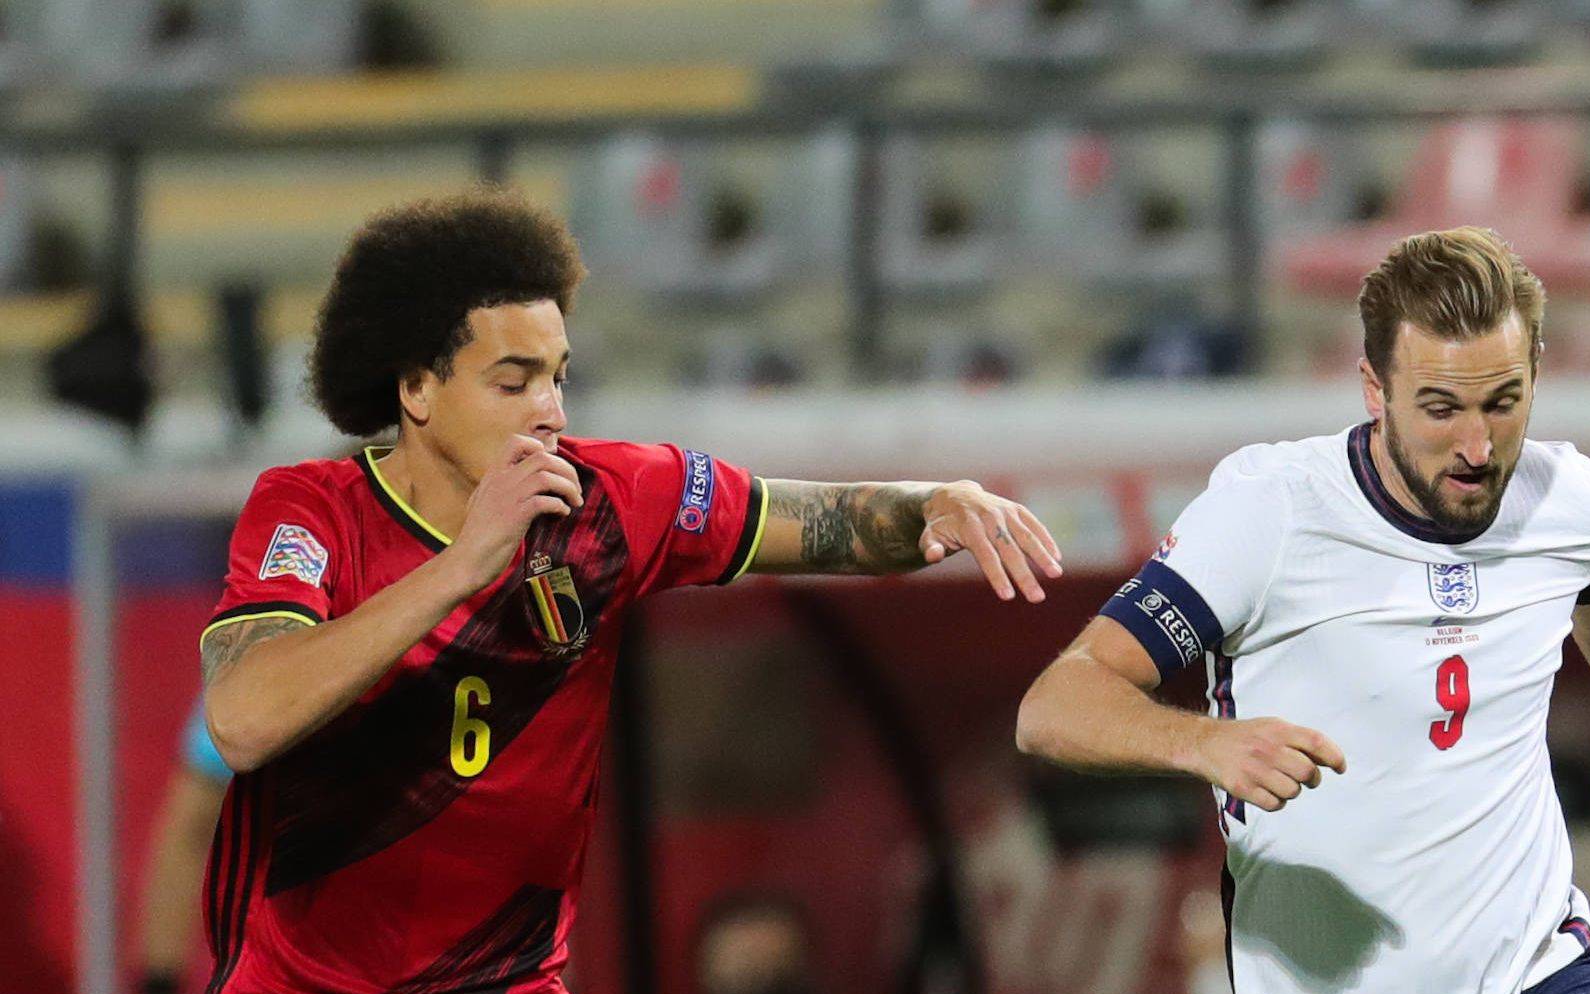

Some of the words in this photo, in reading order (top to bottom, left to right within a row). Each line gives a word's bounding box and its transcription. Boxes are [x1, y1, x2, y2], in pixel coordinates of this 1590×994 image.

[1159, 609, 1199, 665] RESPEC
[450, 675, 492, 778] 6
[1429, 654, 1471, 751] 9
